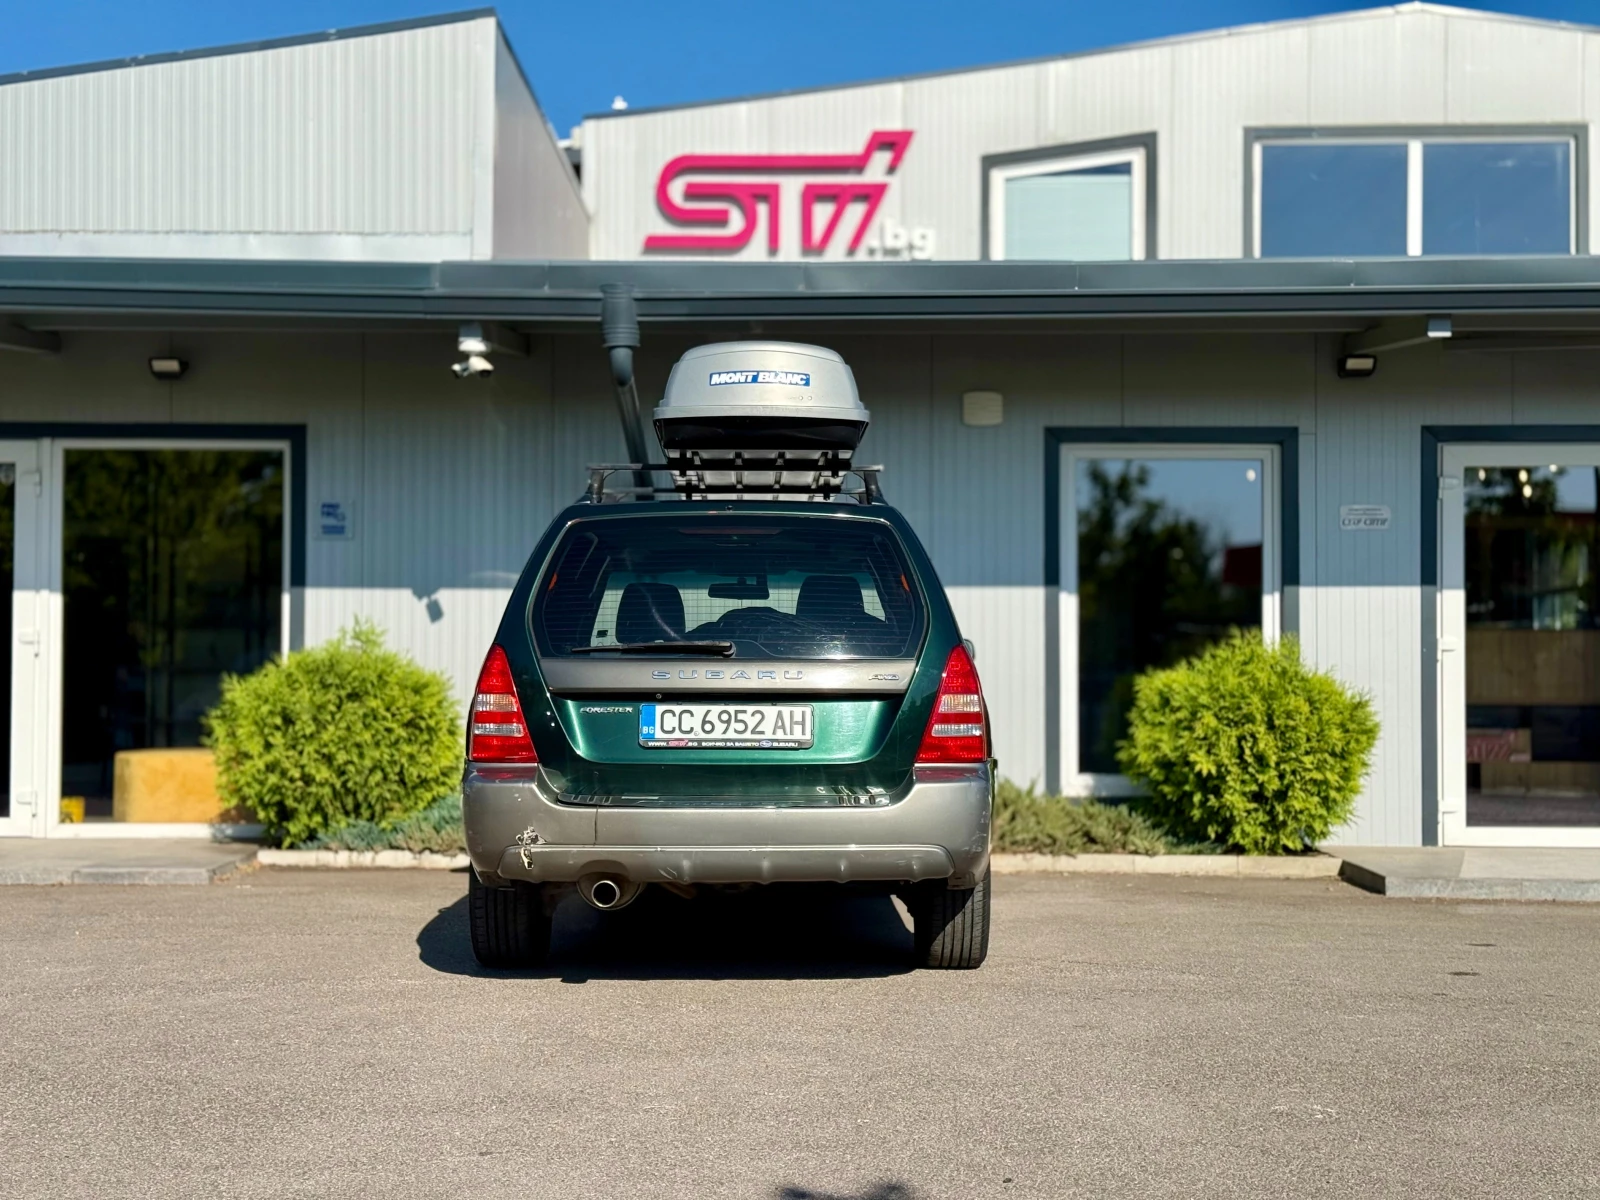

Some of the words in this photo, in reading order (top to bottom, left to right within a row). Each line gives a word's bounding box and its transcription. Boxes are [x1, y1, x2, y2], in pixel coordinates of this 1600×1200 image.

[710, 371, 758, 385] MONT
[757, 371, 807, 385] BLANC
[651, 669, 803, 680] SUBARU
[579, 706, 634, 714] FORESTER
[642, 726, 655, 735] BG
